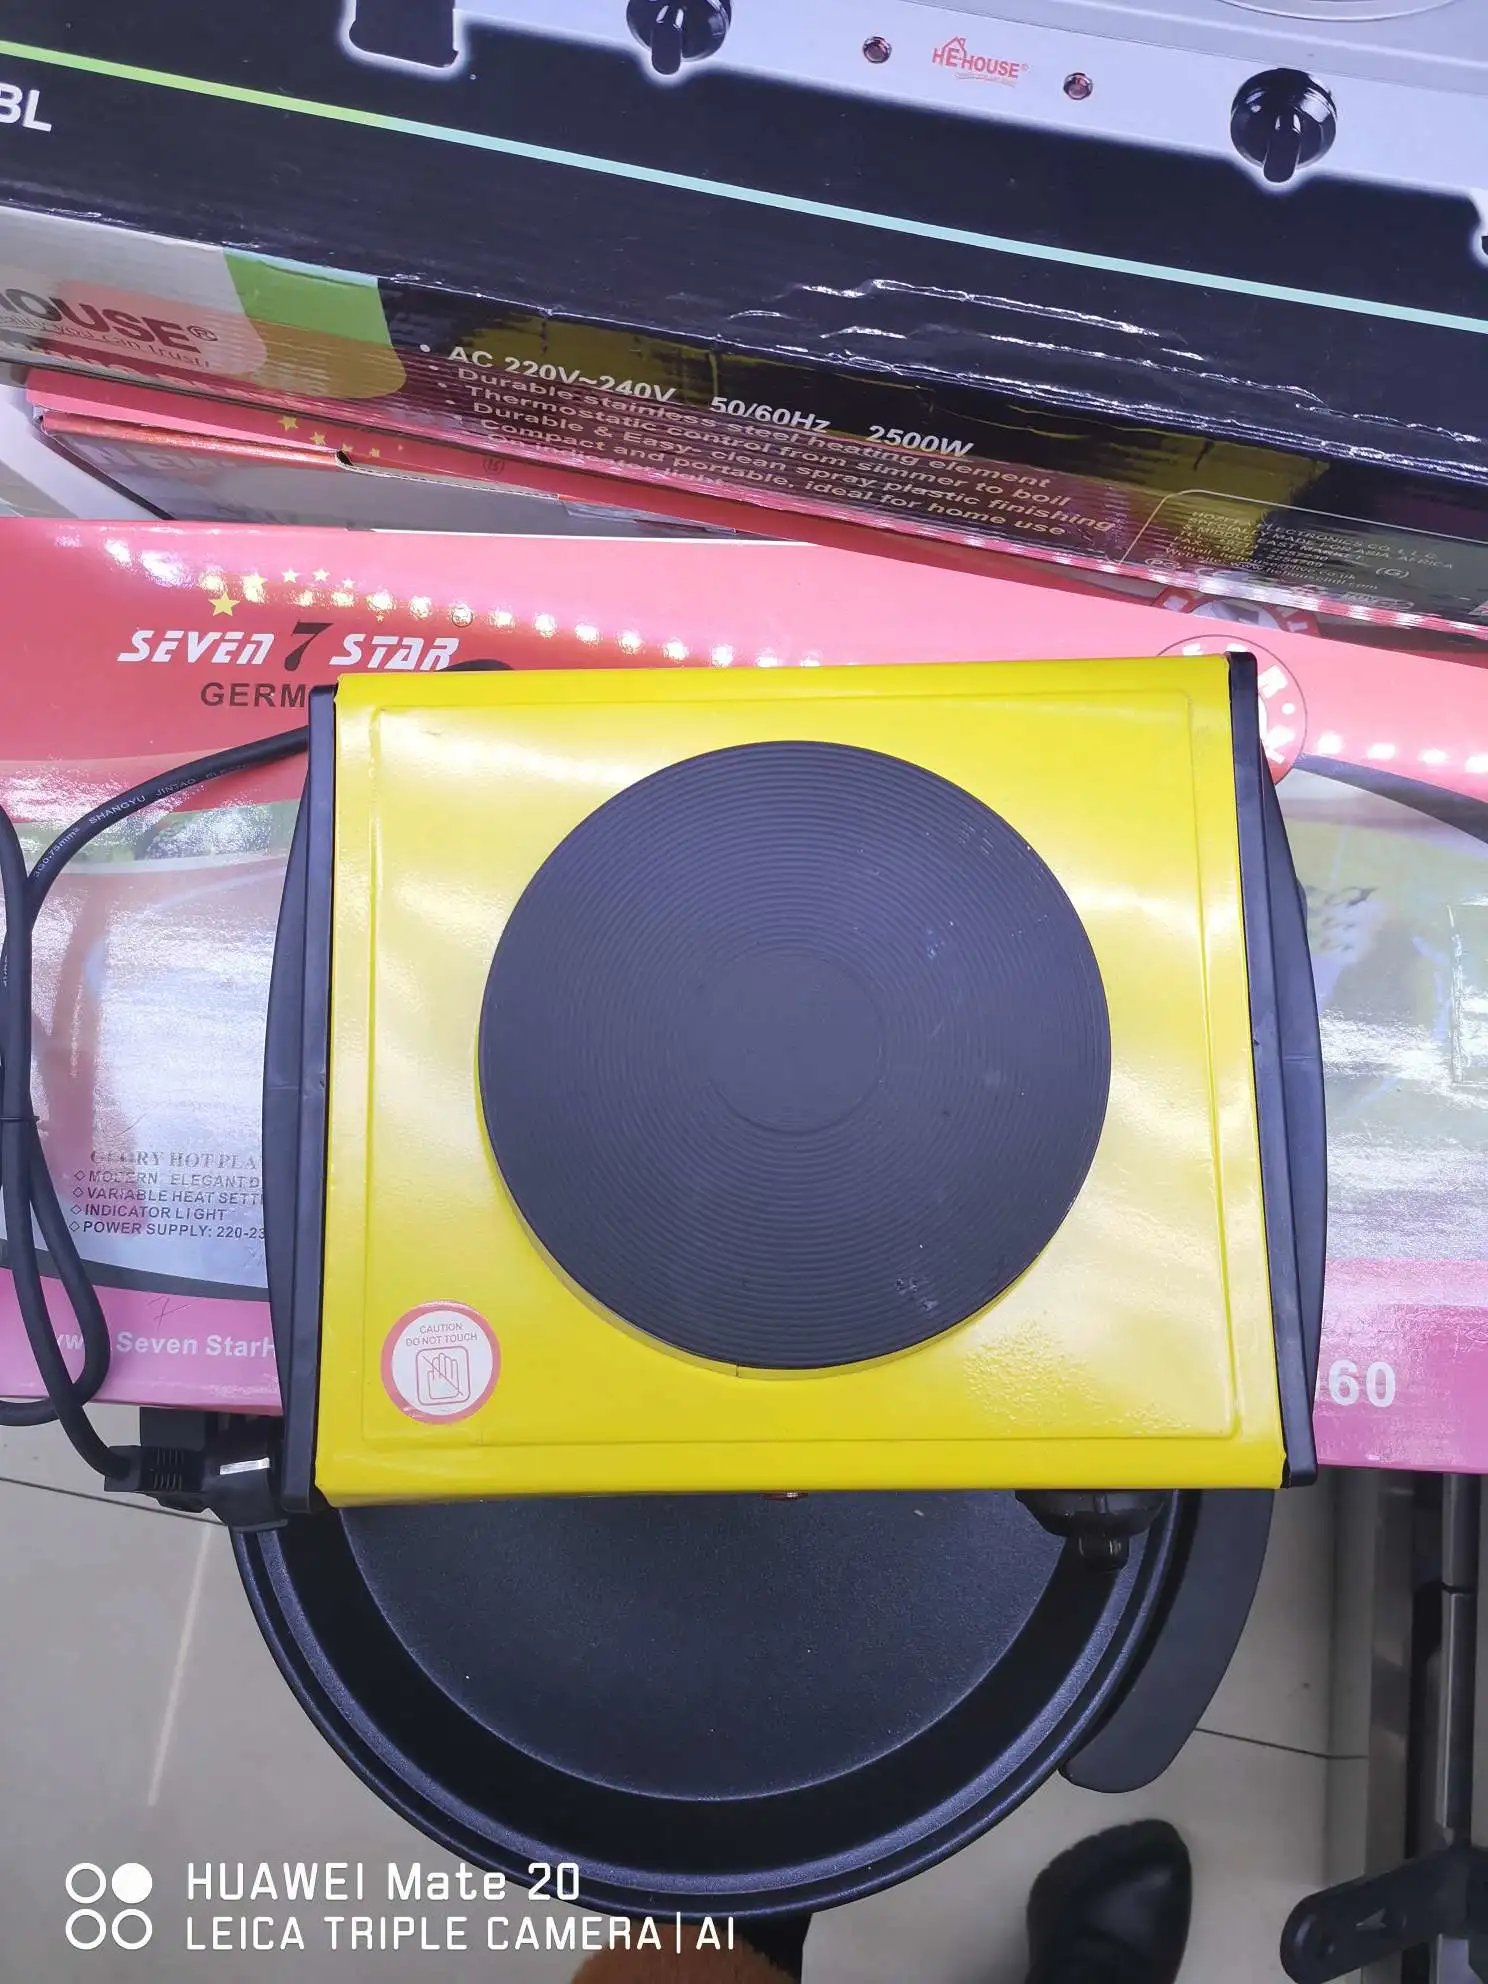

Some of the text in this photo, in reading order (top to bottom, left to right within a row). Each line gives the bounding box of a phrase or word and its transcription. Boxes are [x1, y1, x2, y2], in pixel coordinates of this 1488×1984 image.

[447, 346, 975, 457] AC 220V~240V 50/60Hz 2500W
[457, 367, 1051, 488] Durable stainless steel heating element
[465, 385, 1070, 506] Thermostatic control from simmer to boil
[473, 403, 584, 432] Durable
[594, 426, 614, 439] &
[711, 449, 787, 471] clean
[796, 466, 875, 491] spray
[882, 482, 981, 505] plastic
[988, 499, 1115, 533] finishing
[480, 418, 605, 450] Compact
[614, 443, 664, 462] and
[805, 480, 873, 501] ideal
[880, 493, 922, 509] for
[928, 502, 1007, 525] home
[1015, 519, 1066, 536] use
[117, 621, 461, 672] SEVEN 7 STAR
[201, 682, 306, 708] GERM
[88, 795, 147, 826] SHANGYU
[217, 1153, 257, 1170] PLA
[170, 1173, 245, 1188] ELEGANT
[249, 1177, 260, 1189] D
[86, 1186, 168, 1202] VARIABLE
[172, 1190, 215, 1204] HEAT
[84, 1203, 227, 1221] INDICATOR LIGHT
[83, 1220, 265, 1240] POWER SUPPLY: 220-23
[405, 1333, 478, 1346] DO NOT TOUCH
[420, 1322, 463, 1334] CAUTION
[116, 1331, 197, 1355] Seven
[206, 1334, 275, 1358] StarH
